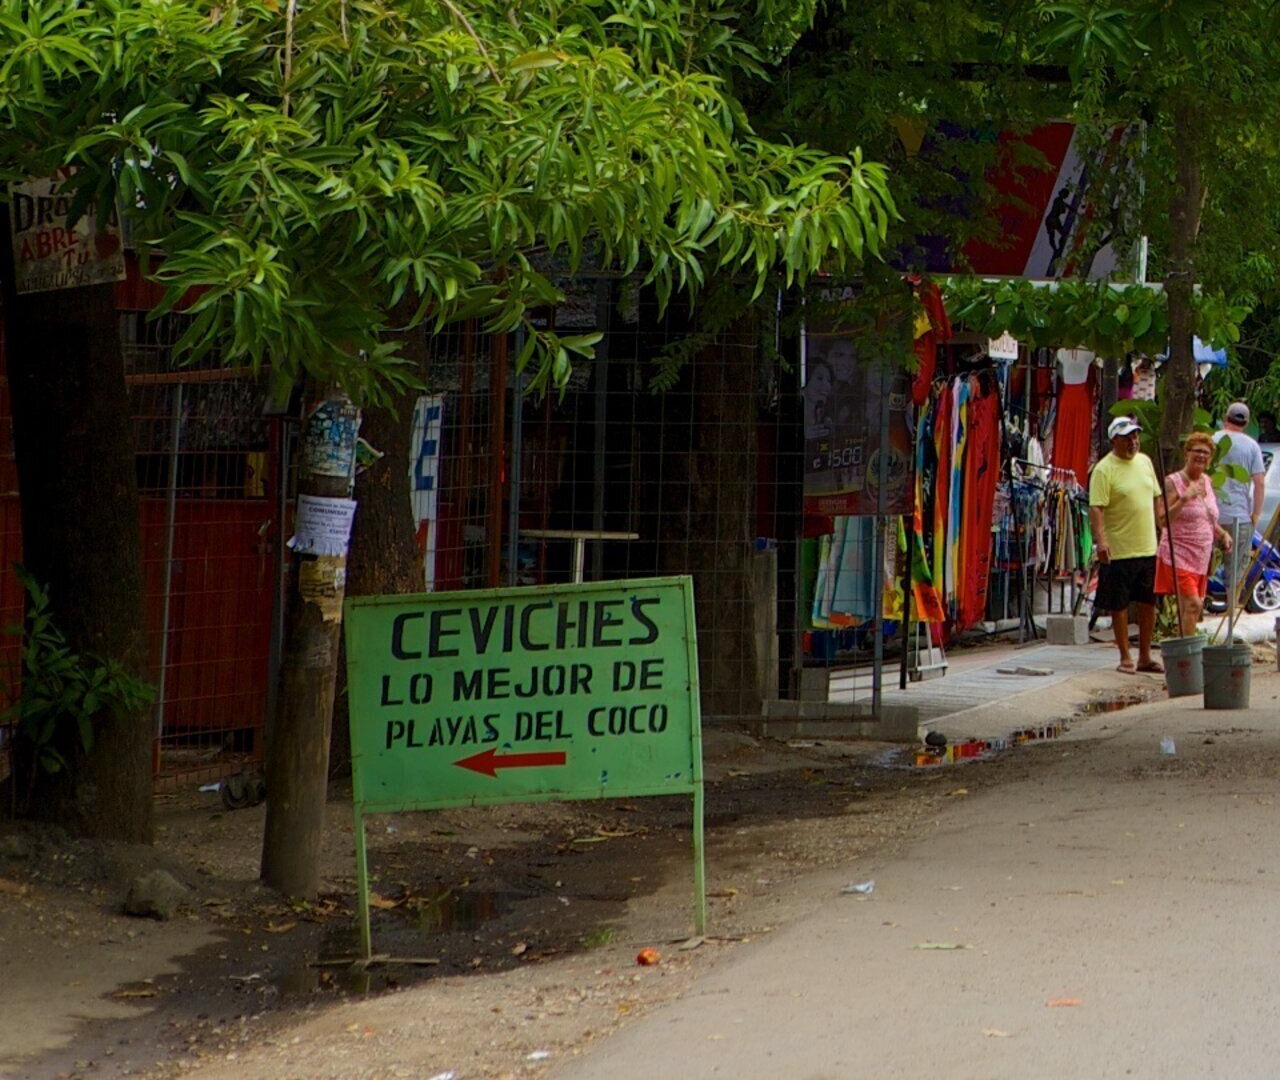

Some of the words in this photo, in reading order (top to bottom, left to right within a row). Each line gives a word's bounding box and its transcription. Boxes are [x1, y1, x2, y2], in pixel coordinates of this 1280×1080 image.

[20, 227, 79, 263] ABRE
[391, 598, 661, 660] CEVICHES
[380, 673, 433, 707] LO
[452, 663, 593, 702] MEJOR
[612, 658, 664, 692] DE
[385, 713, 501, 750] PLAYAS
[514, 710, 573, 742] DEL
[587, 704, 669, 737] COCO
